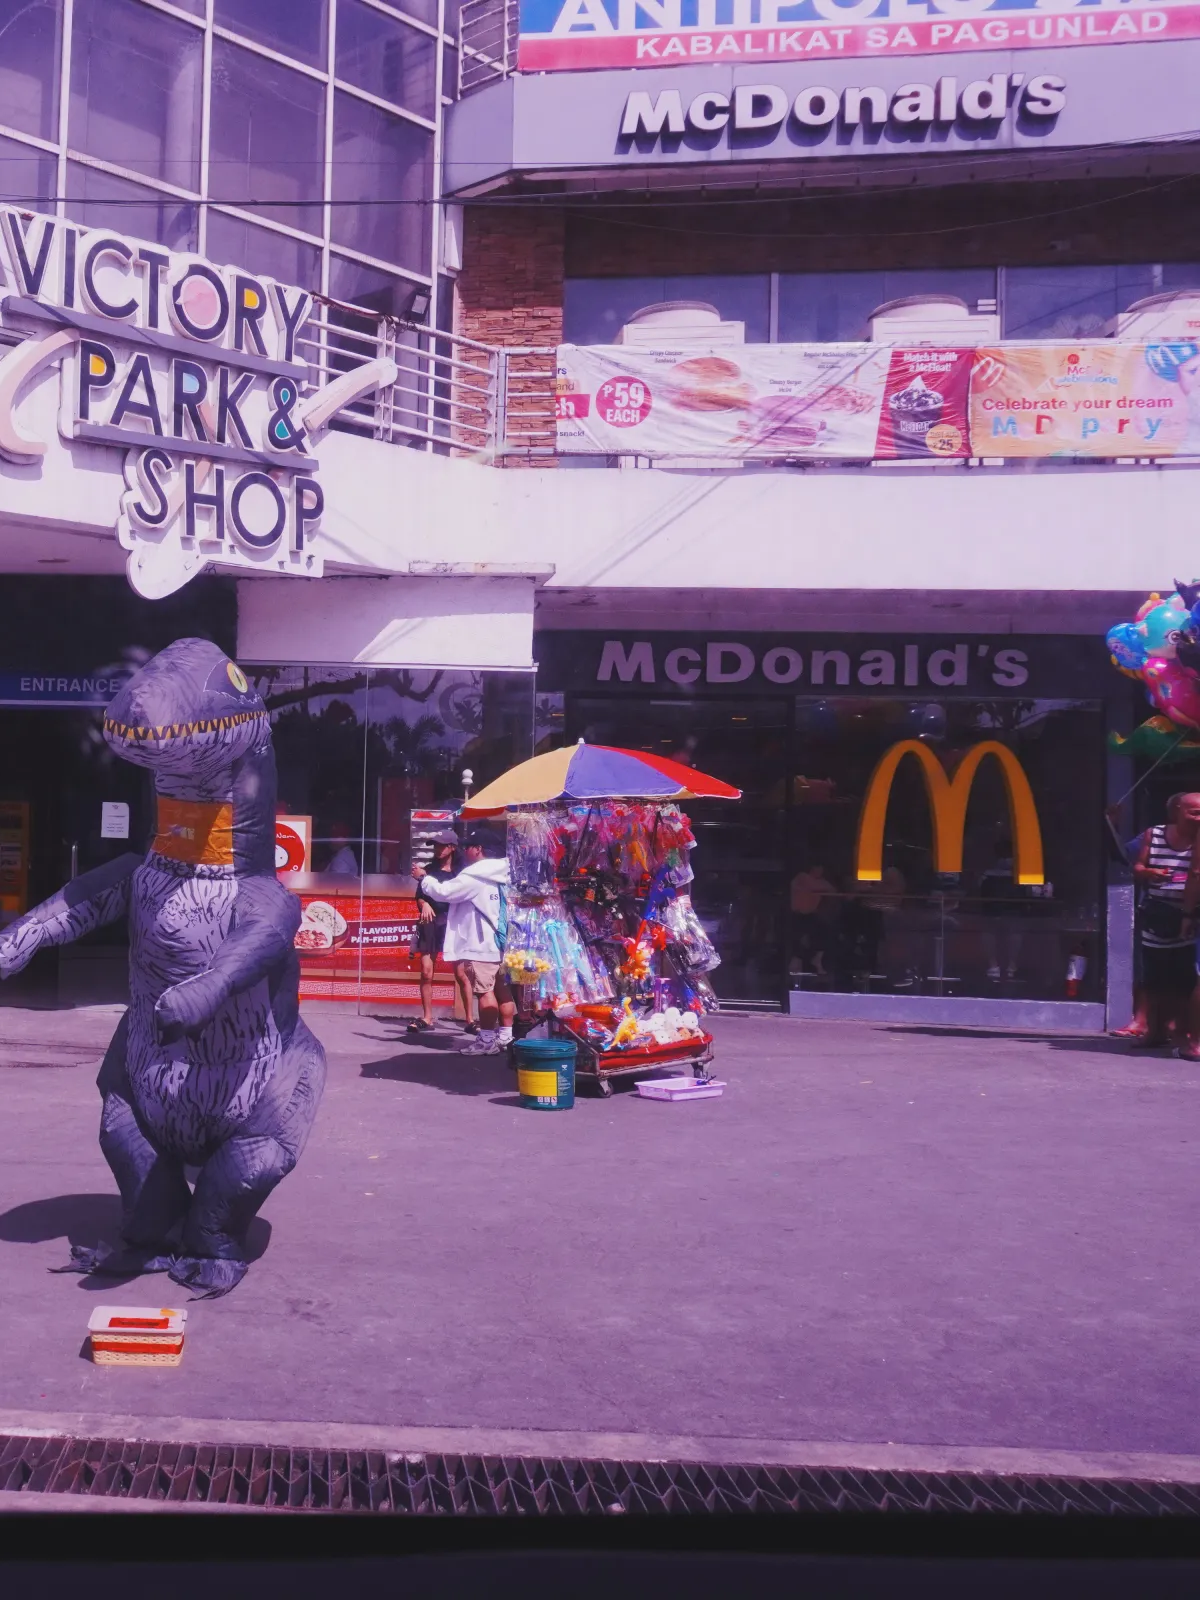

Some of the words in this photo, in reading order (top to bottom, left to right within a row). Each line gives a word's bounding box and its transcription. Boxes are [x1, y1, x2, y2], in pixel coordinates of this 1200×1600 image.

[636, 30, 852, 59] KABALIKAT
[865, 26, 918, 49] SA
[931, 12, 1169, 45] PAG-UNLAD
[617, 71, 1068, 140] McDonald's
[0, 208, 310, 363] VICTORY
[77, 337, 257, 450] PARK
[266, 376, 310, 456] &
[606, 409, 640, 423] EACH
[982, 397, 1068, 411] Celebrate
[1073, 398, 1112, 412] your
[1116, 396, 1174, 409] dream
[132, 448, 325, 553] SHOP
[19, 677, 121, 693] ENTRANCE
[596, 640, 1029, 687] McDonald's
[351, 934, 399, 943] PAN-FRIED
[359, 926, 409, 934] FLAVORFUL
